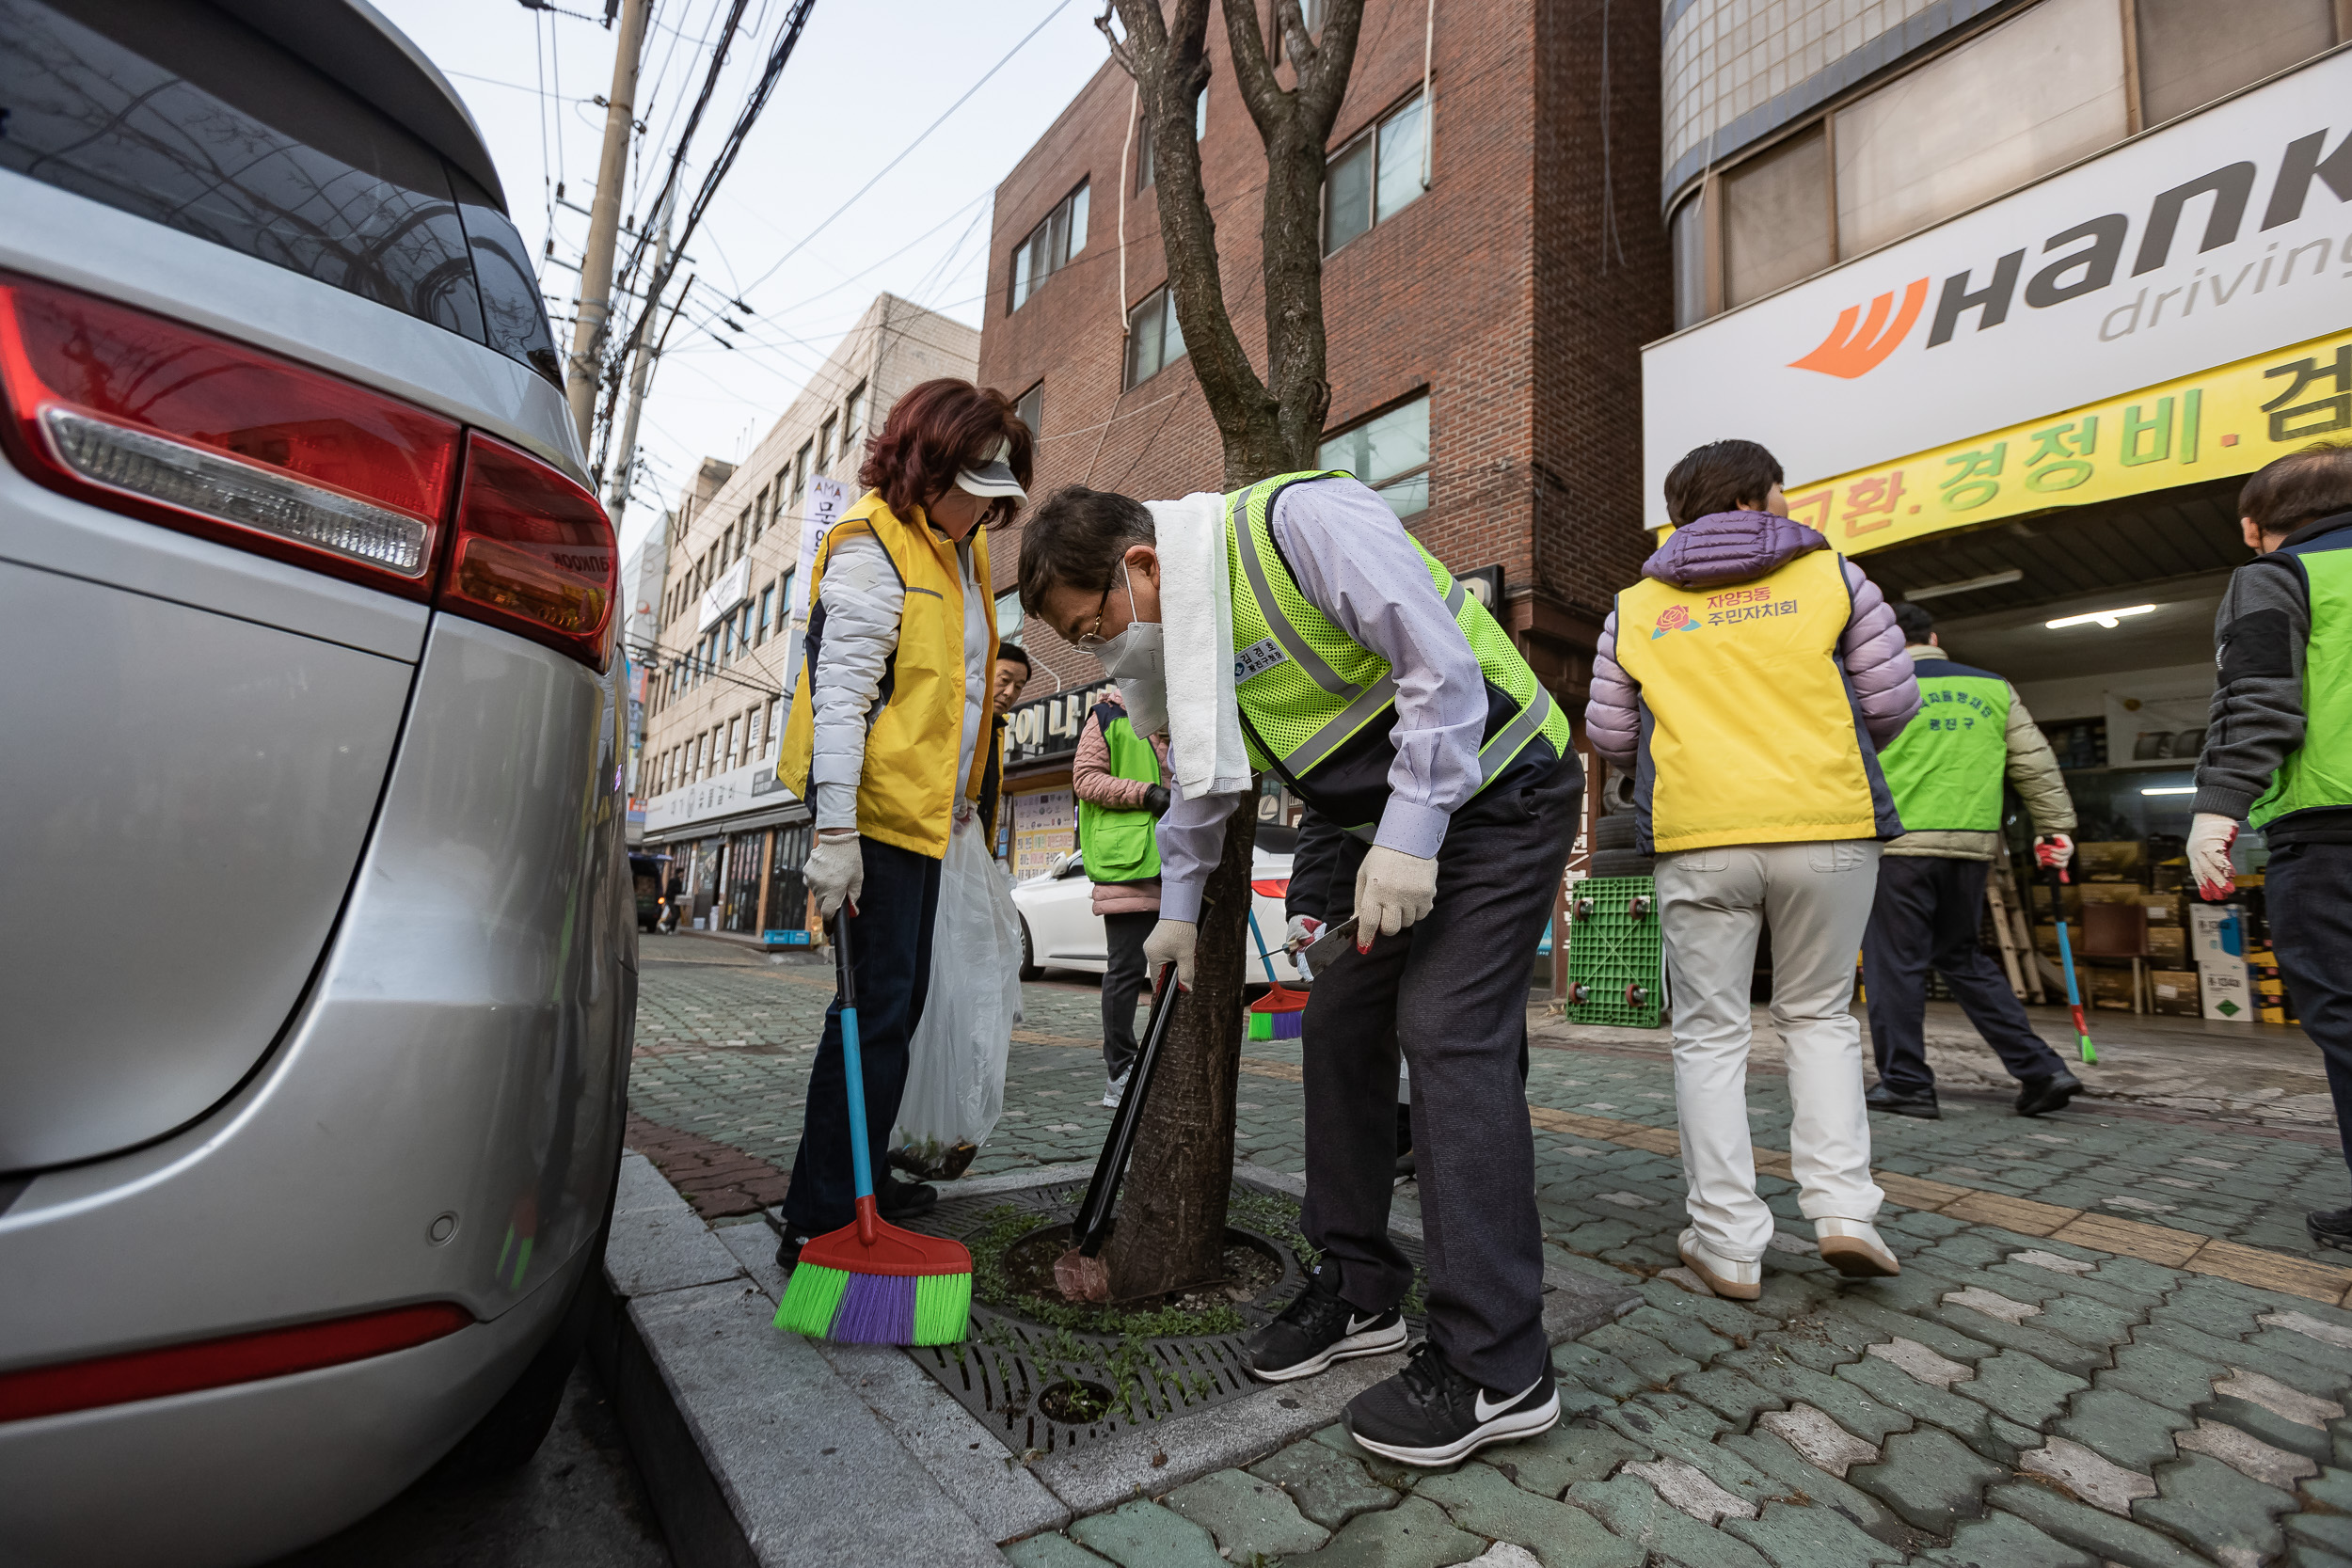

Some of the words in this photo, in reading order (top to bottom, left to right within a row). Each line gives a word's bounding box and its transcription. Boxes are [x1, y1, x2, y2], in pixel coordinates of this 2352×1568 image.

[814, 482, 842, 500] AMA
[1707, 586, 1772, 610] 자양3동
[1708, 599, 1798, 626] 주민자치회
